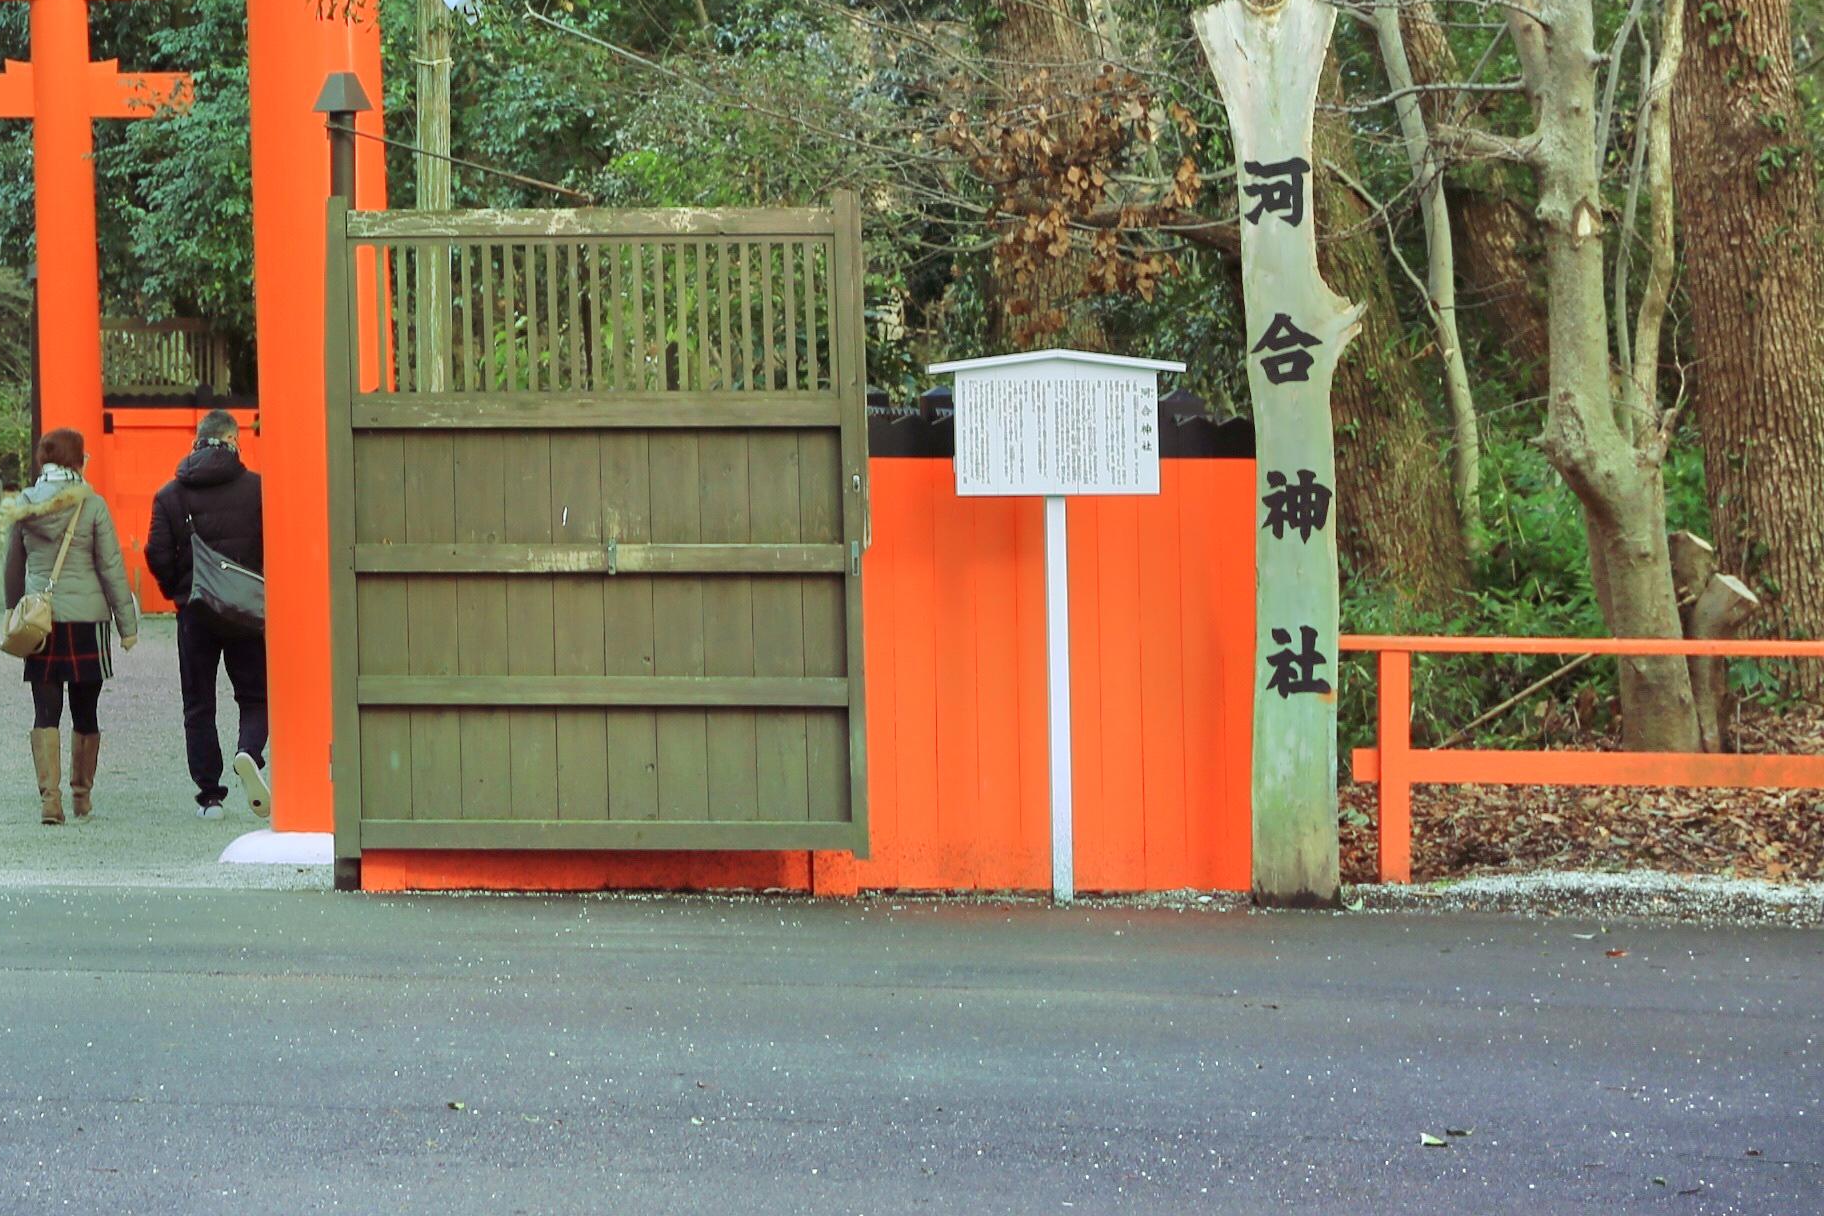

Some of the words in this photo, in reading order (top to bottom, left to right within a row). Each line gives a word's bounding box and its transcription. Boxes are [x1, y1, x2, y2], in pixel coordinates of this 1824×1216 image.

[1140, 387, 1153, 452] 河合神社
[1243, 157, 1333, 699] 河合神社
